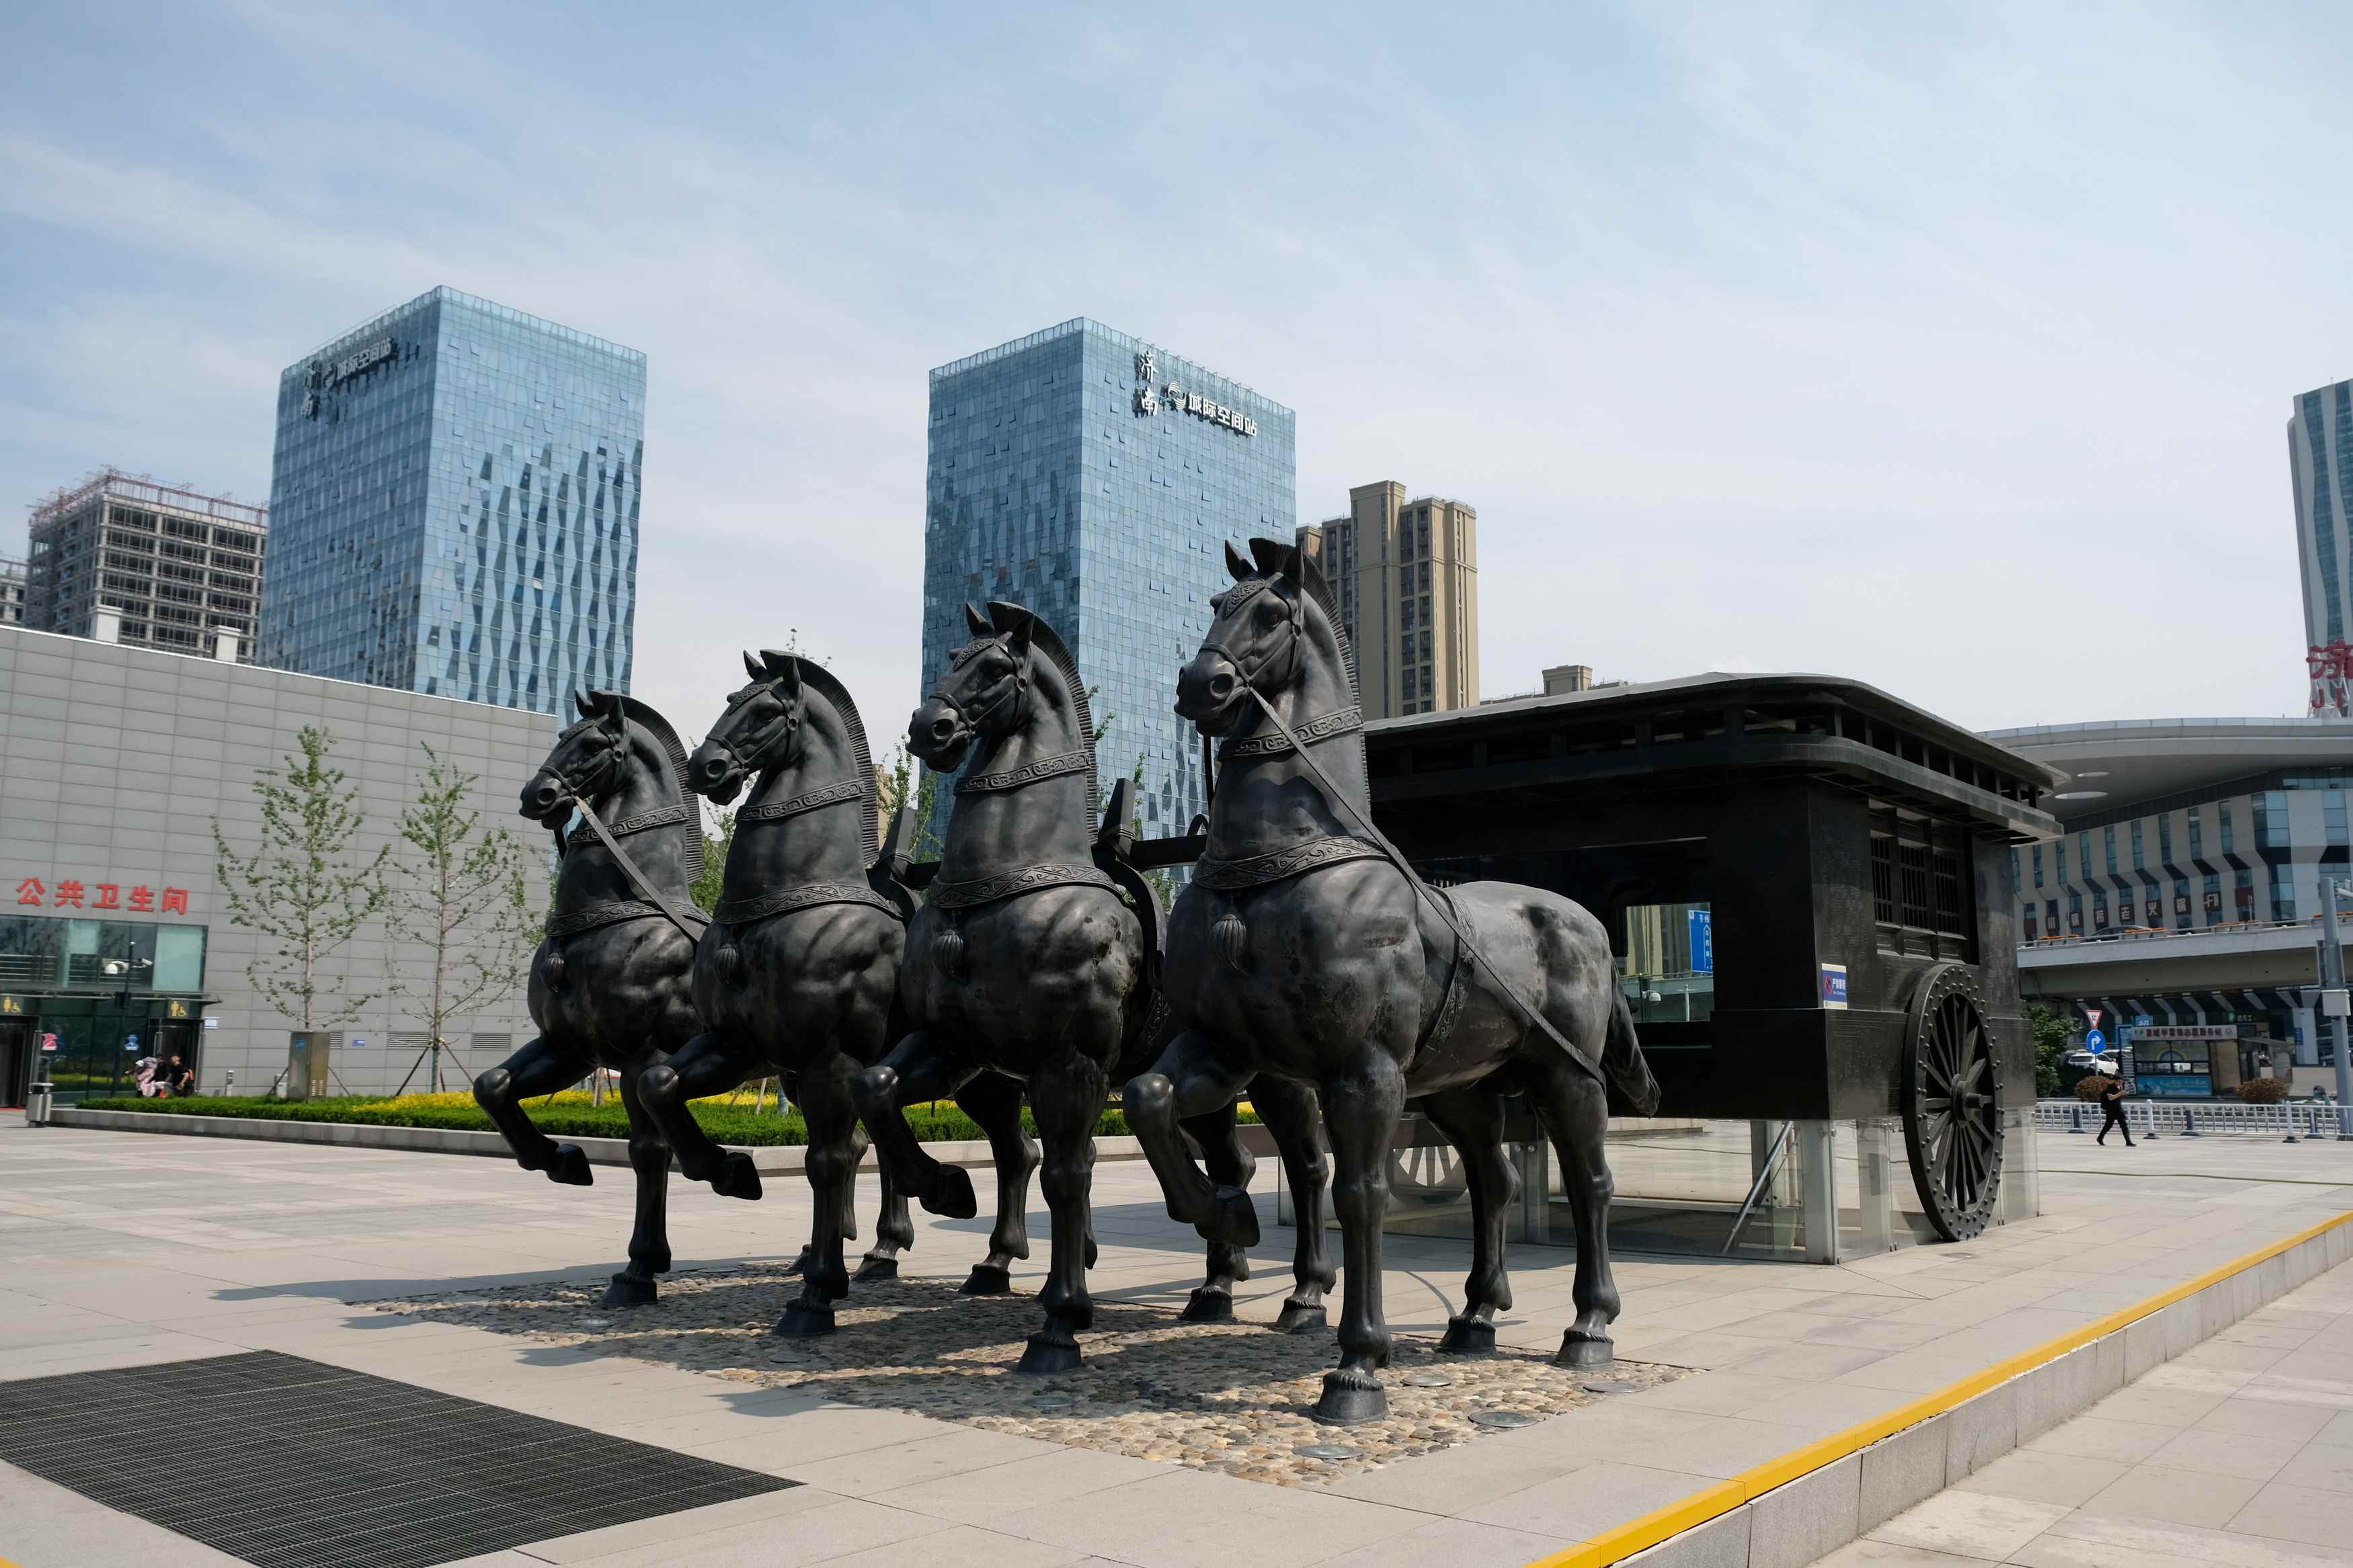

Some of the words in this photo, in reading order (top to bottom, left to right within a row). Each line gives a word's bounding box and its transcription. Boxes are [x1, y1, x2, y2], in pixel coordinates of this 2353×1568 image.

[1139, 350, 1159, 416] 济南
[1188, 392, 1257, 437] 城际空间站
[16, 876, 189, 915] 公共卫生间
